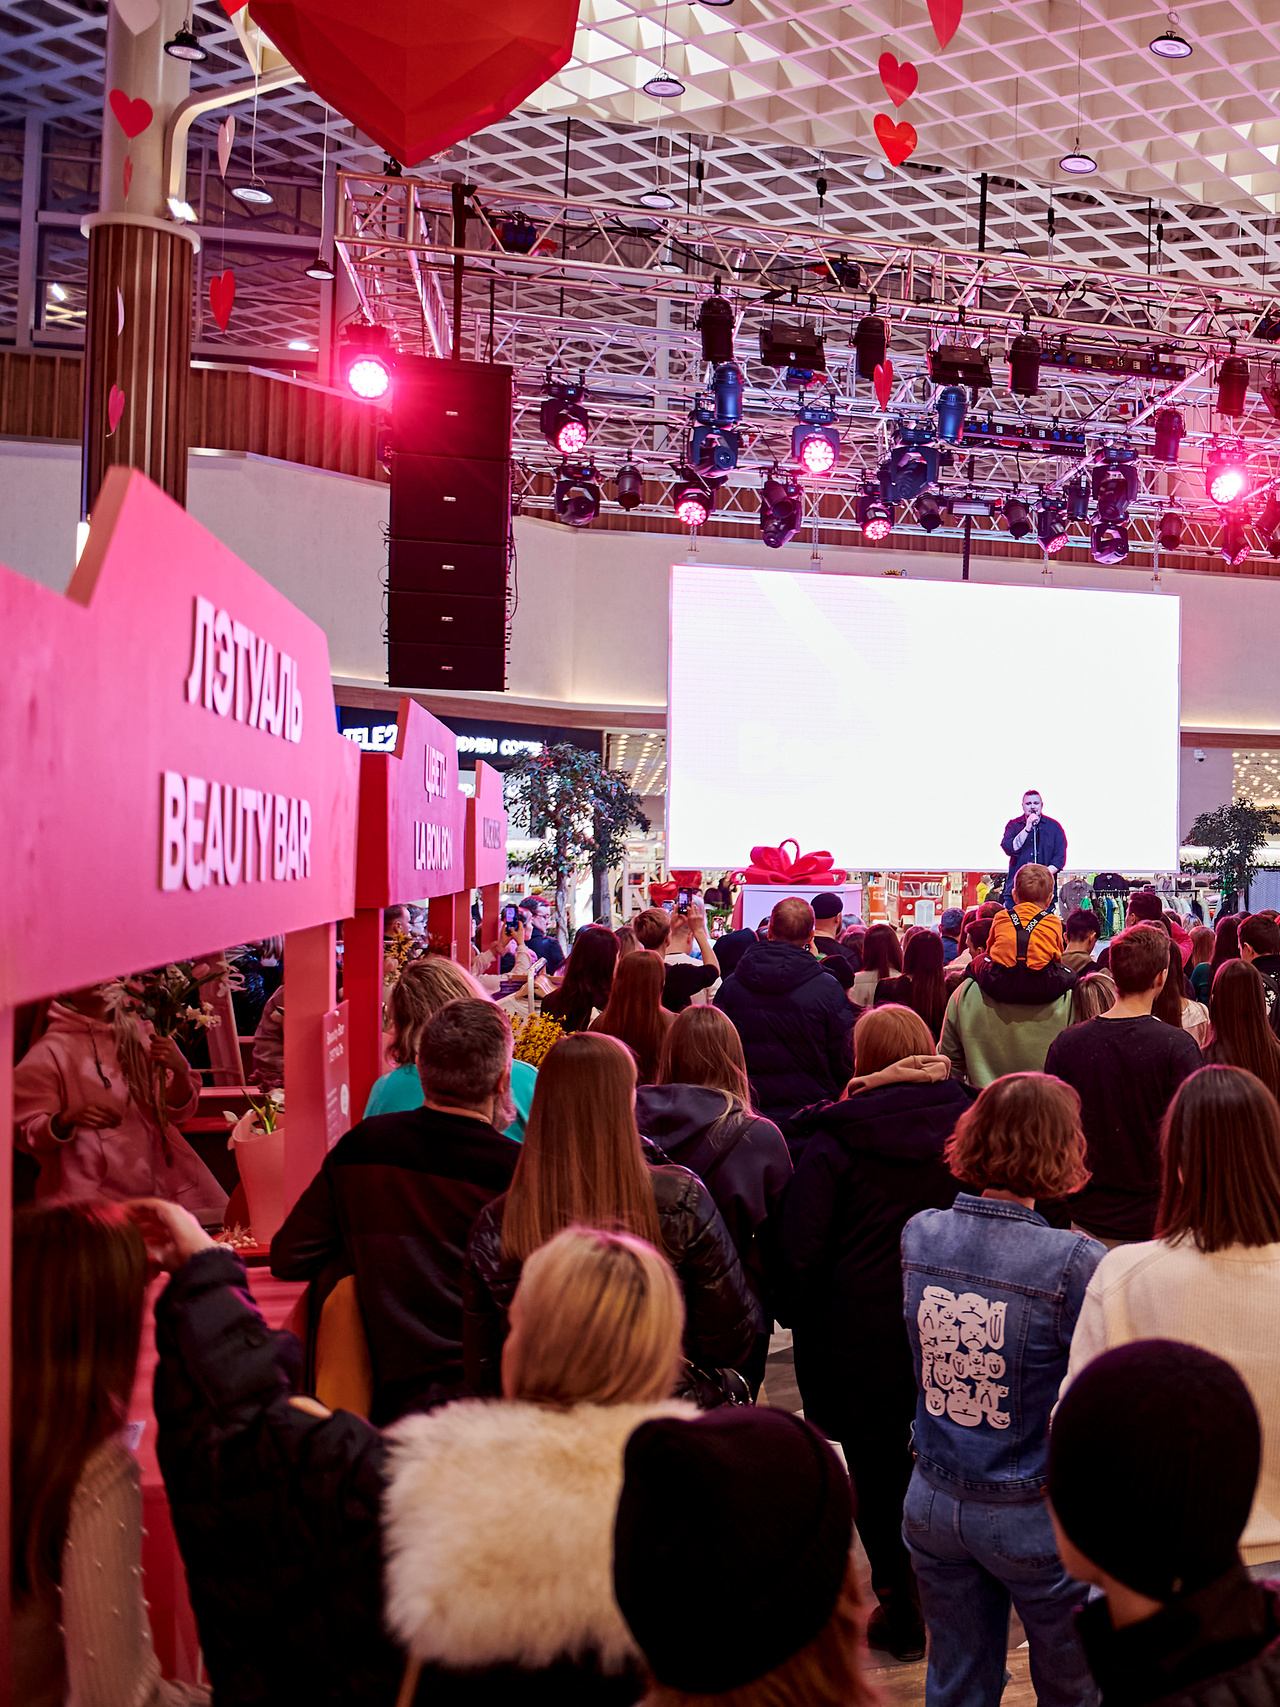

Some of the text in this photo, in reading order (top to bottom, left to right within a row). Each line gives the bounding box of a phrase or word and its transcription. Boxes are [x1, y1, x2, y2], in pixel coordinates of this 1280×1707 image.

[185, 594, 303, 744] ЛЭТУАЛЬ
[160, 769, 312, 891] BEAUTY BAR
